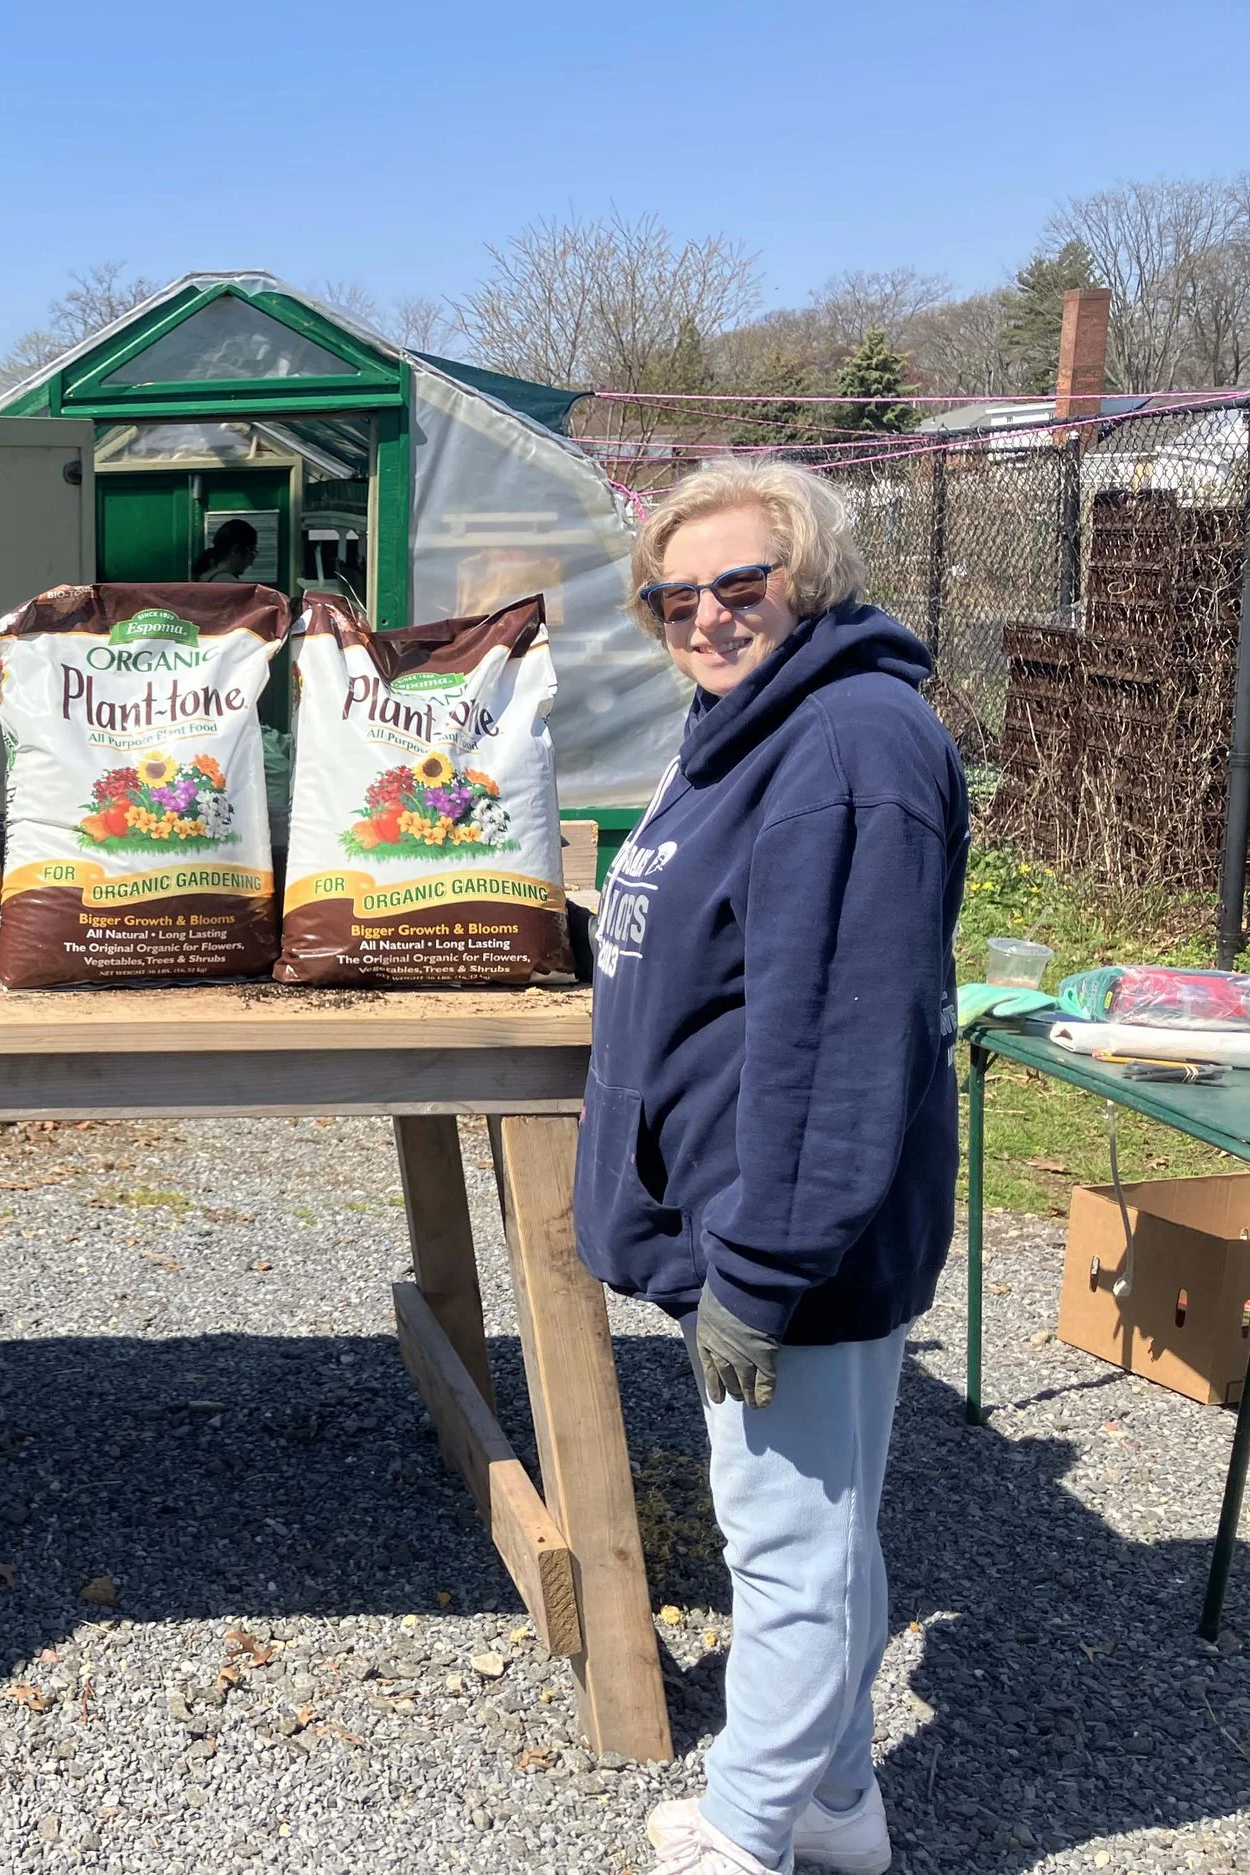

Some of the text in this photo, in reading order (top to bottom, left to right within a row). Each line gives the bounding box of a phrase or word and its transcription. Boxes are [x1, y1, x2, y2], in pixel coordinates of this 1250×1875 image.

[137, 612, 158, 620] SINCE
[126, 622, 184, 636] Espoma
[61, 663, 245, 731] Plant-tone
[89, 733, 105, 743] All
[108, 736, 154, 749] Purpose
[189, 723, 217, 734] Food
[367, 728, 383, 741] All
[44, 866, 75, 880] FOR
[92, 872, 262, 900] ORGANIC GARDENING
[314, 878, 345, 894] FOR
[363, 878, 548, 910] ORGANIC GARDENING
[79, 914, 236, 928] Bigger Growth & Blooms
[86, 928, 227, 941] All Natural Long Lasting
[351, 923, 519, 939] Bigger Growth & Blooms
[64, 941, 245, 954] The Original Organic for Flowers,
[359, 938, 510, 952] All Natural Long Lasting
[83, 956, 145, 968] Vegetables,
[146, 955, 174, 965] Trees
[189, 953, 226, 963] Shrubs
[336, 952, 531, 966] The Original Organic for Flowers,
[423, 964, 454, 973] Trees
[469, 963, 510, 973] Shrubs
